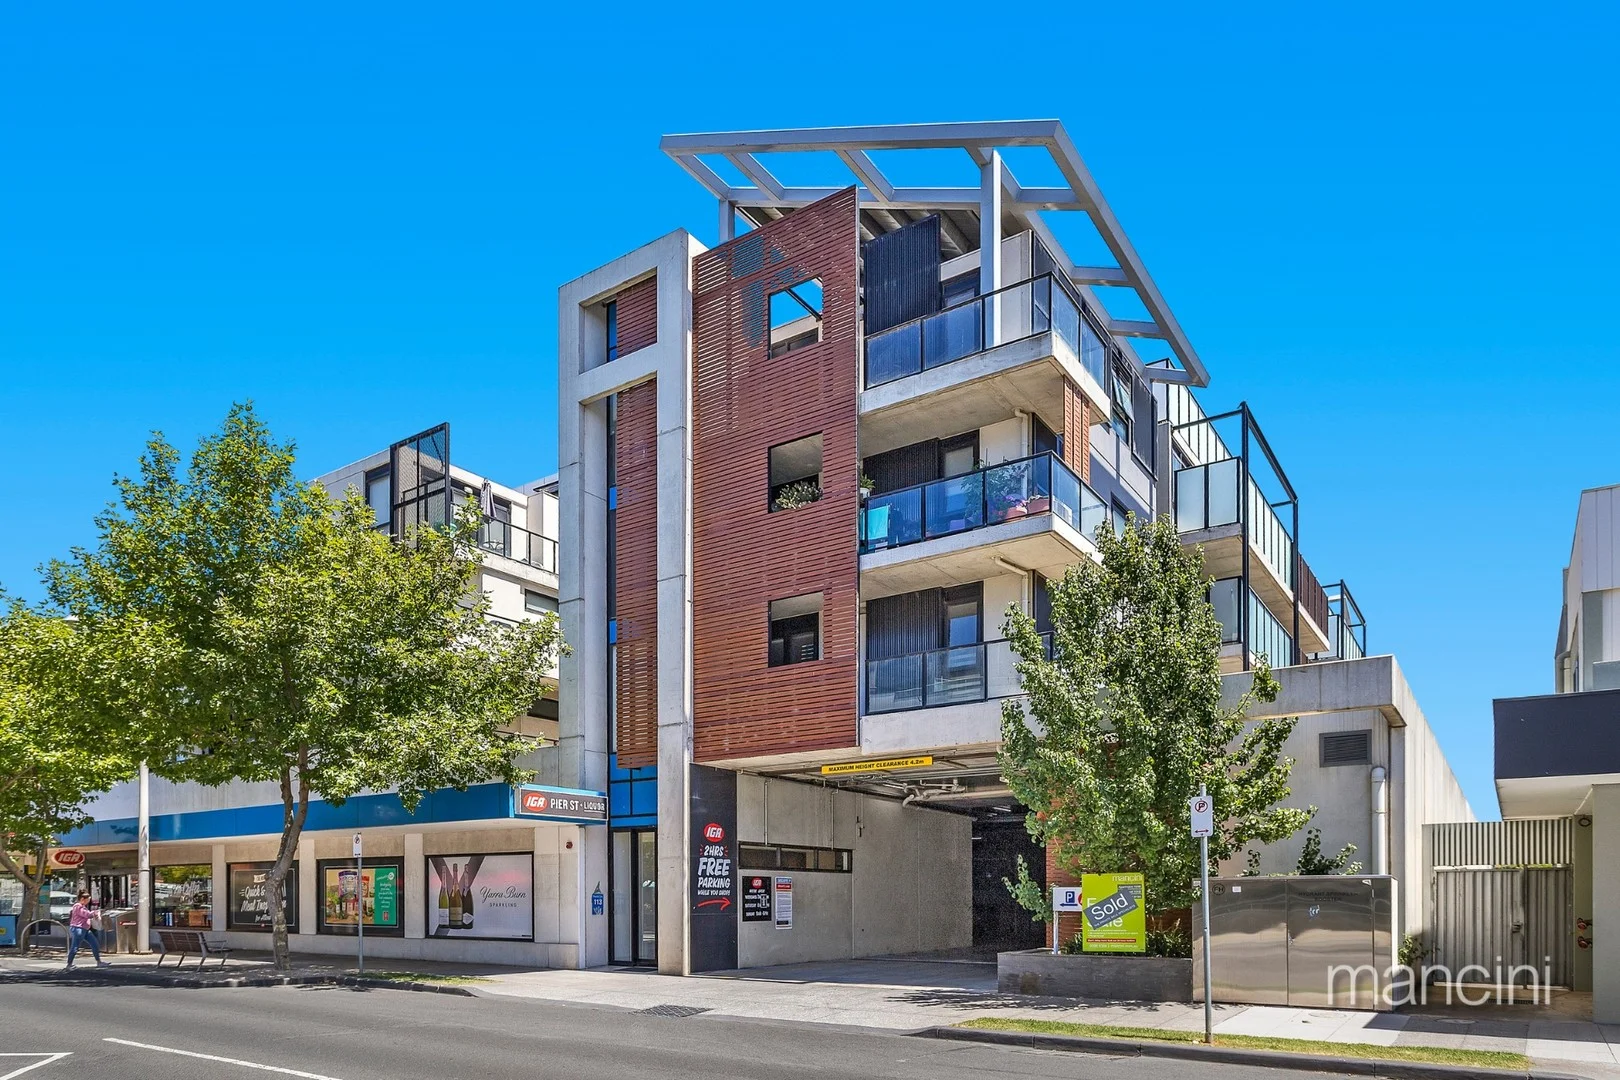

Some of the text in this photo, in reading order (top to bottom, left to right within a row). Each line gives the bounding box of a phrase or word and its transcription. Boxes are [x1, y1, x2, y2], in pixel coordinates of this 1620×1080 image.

[828, 764, 854, 772] MAXIMUM
[876, 760, 908, 768] CLEARANCE
[526, 796, 546, 808] IGA
[550, 798, 568, 811] PIER
[569, 800, 580, 811] ST
[706, 827, 723, 838] IGA
[703, 845, 724, 857] 2HRS
[57, 853, 81, 862] IGA
[697, 857, 731, 876] FREE
[697, 877, 731, 889] PARKING
[480, 886, 526, 903] Yarra Burn
[1091, 893, 1129, 920] Sold
